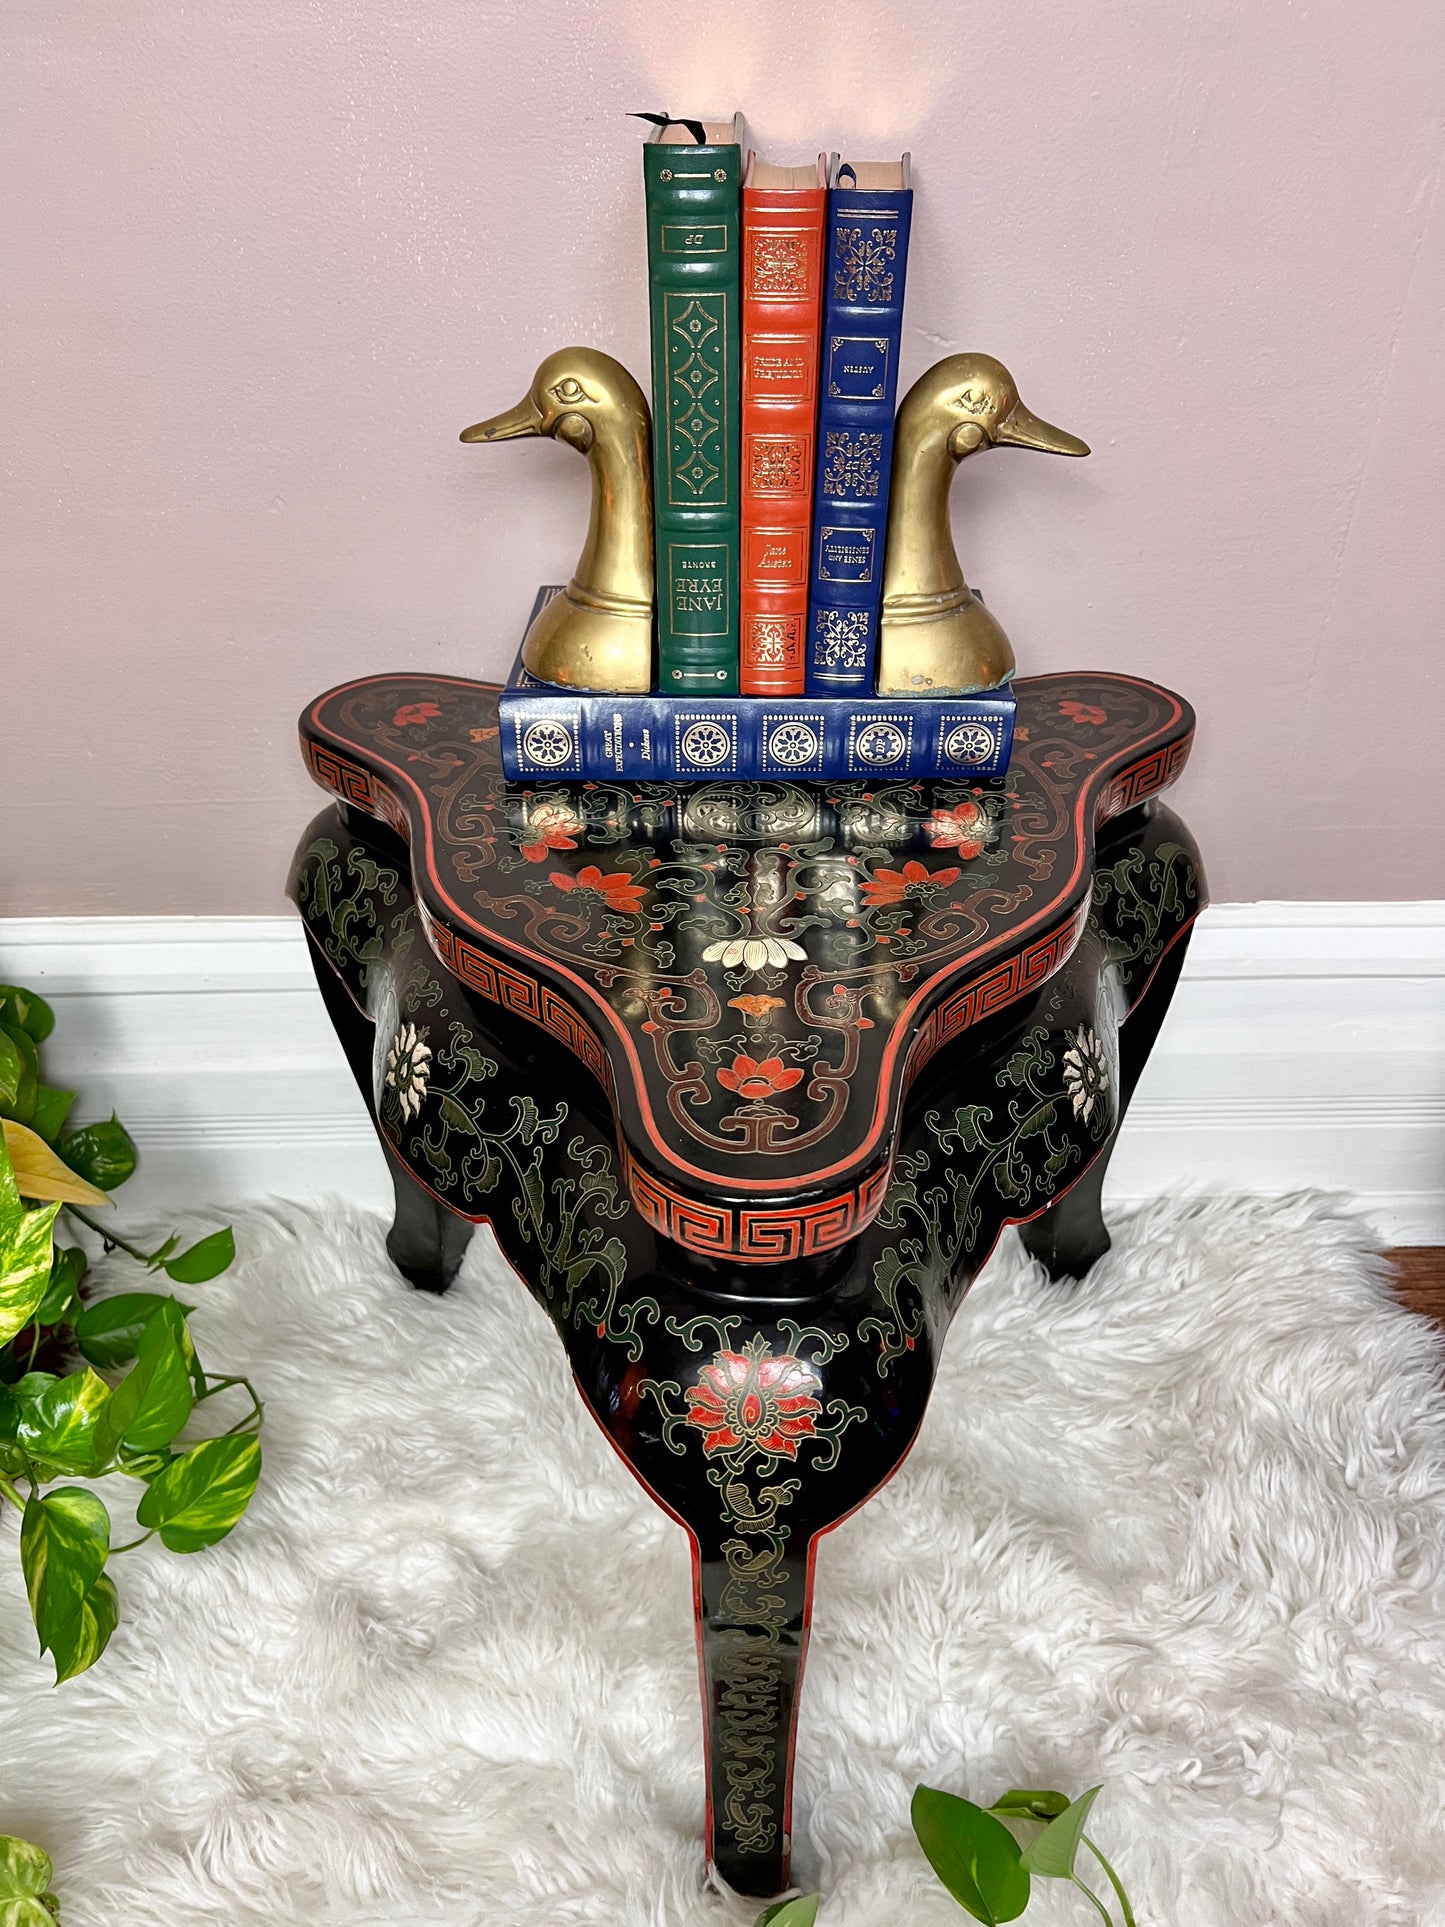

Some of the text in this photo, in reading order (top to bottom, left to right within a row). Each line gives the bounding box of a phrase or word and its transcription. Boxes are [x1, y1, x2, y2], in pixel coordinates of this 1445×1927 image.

[684, 234, 704, 245] DP
[843, 365, 874, 374] AUSTEN
[825, 544, 870, 555] SENSIBILITY
[828, 554, 866, 564] SENSE AND
[675, 578, 723, 593] EYRE
[676, 593, 724, 611] JANE
[603, 730, 613, 758] GREAT
[613, 713, 624, 772] EXPECTATIONS
[640, 728, 651, 760] Dickens
[875, 738, 886, 754] DP
